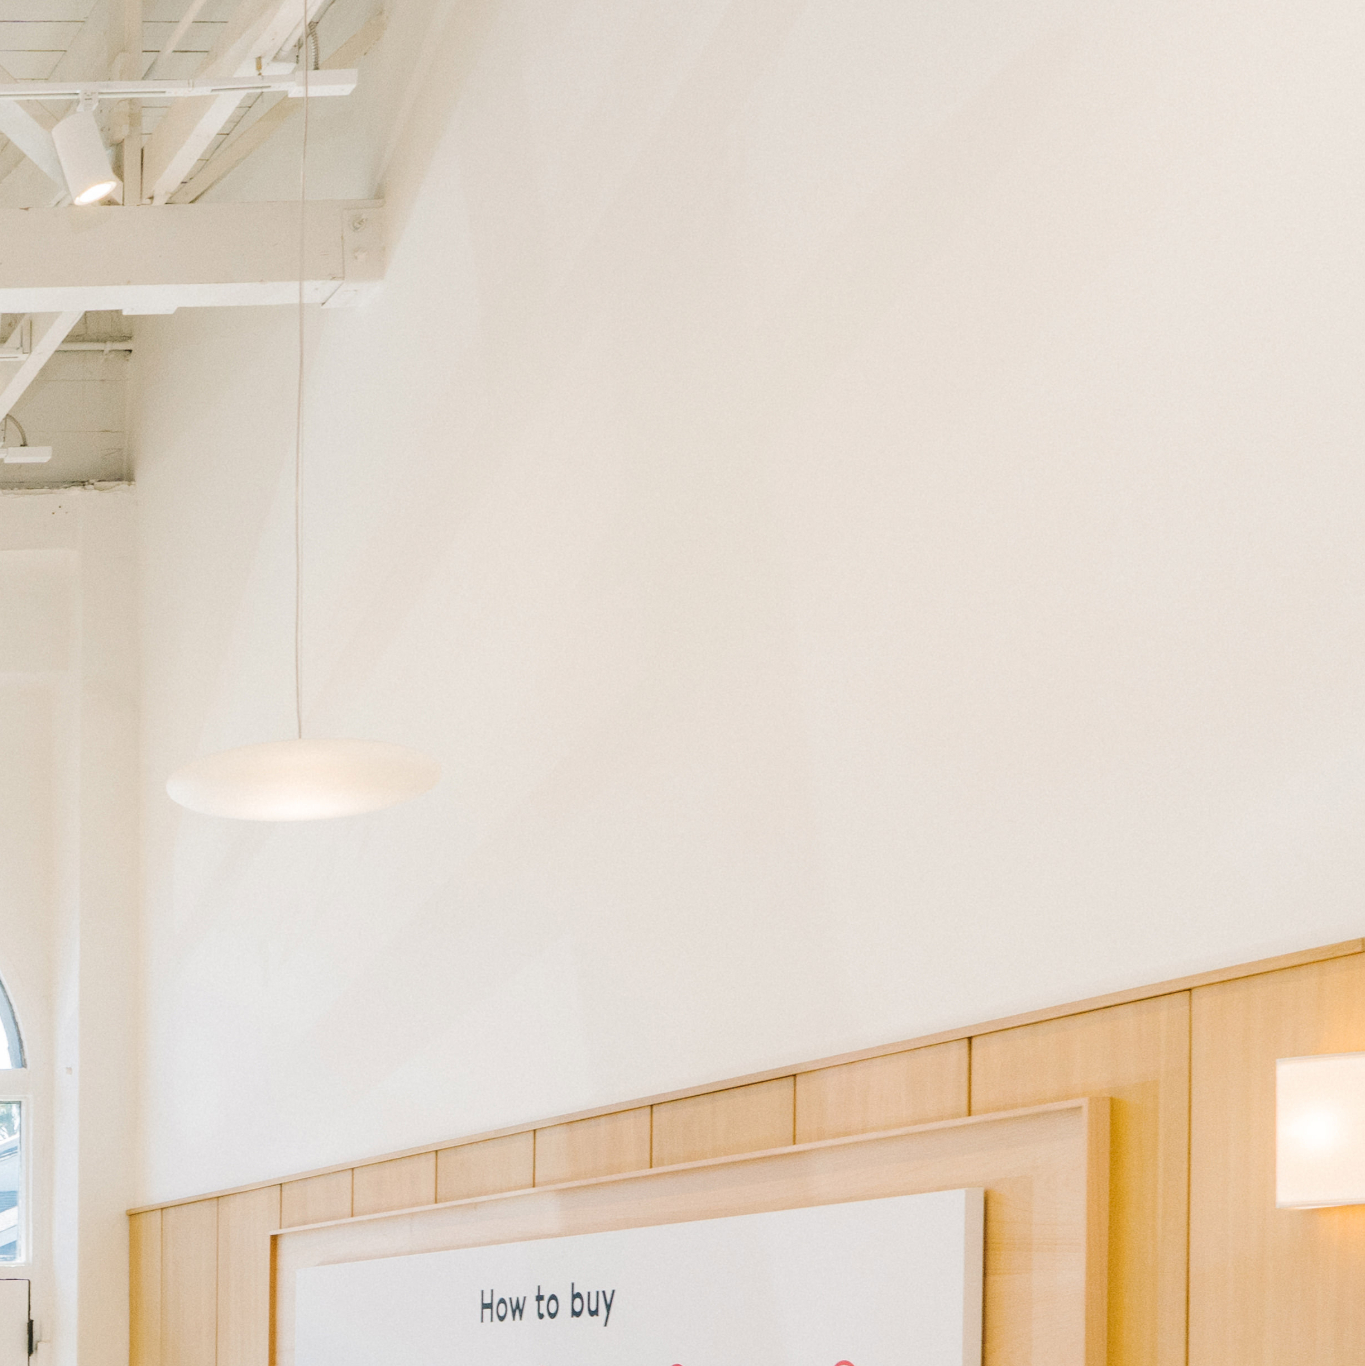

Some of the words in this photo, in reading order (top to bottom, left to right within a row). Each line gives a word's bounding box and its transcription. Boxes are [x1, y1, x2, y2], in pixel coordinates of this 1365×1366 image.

[480, 1288, 527, 1323] How
[535, 1284, 559, 1320] to
[571, 1282, 615, 1328] buy
